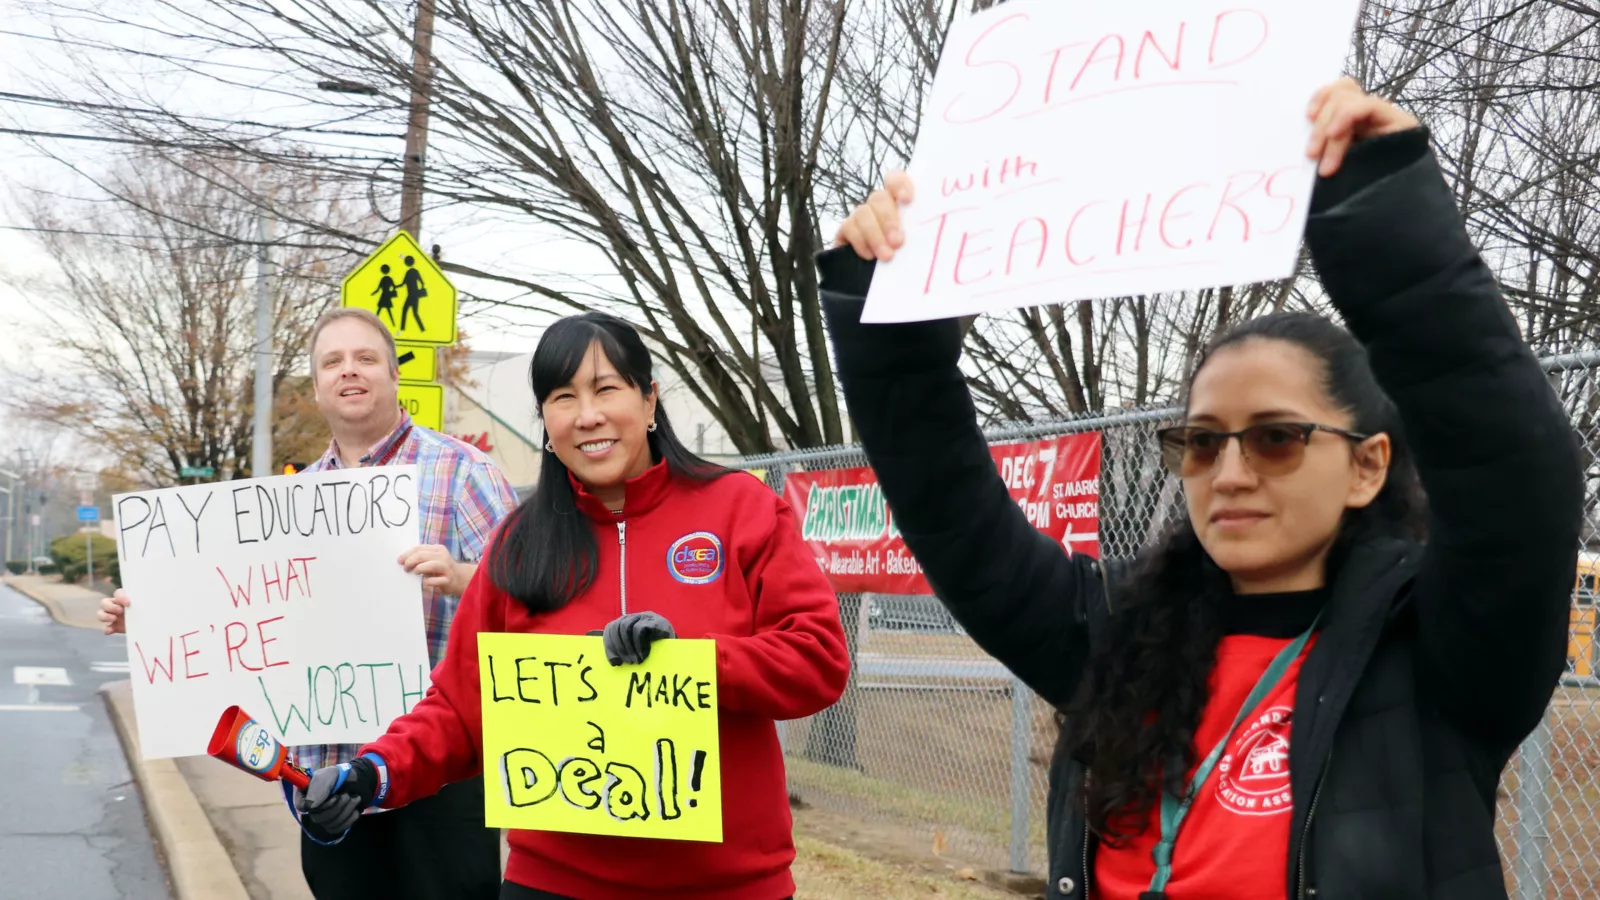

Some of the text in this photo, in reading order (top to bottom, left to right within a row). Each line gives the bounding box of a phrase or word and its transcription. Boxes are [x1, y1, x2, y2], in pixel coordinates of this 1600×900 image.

[943, 8, 1268, 124] STAND
[941, 155, 1039, 198] with
[918, 165, 1304, 295] TEACHERS
[1001, 446, 1057, 497] DEC. 7
[118, 474, 411, 561] PAY EDUCATORS
[802, 481, 887, 546] CHRISTMAS
[1056, 502, 1098, 519] CHURCH
[216, 557, 317, 608] WHAT
[830, 550, 864, 574] Wearable
[865, 550, 880, 574] Art
[135, 616, 290, 684] WE'RE
[259, 663, 423, 737] WORTH
[488, 654, 711, 711] LET'S MAKE
[587, 721, 605, 753] a
[501, 738, 707, 821] Deal!
